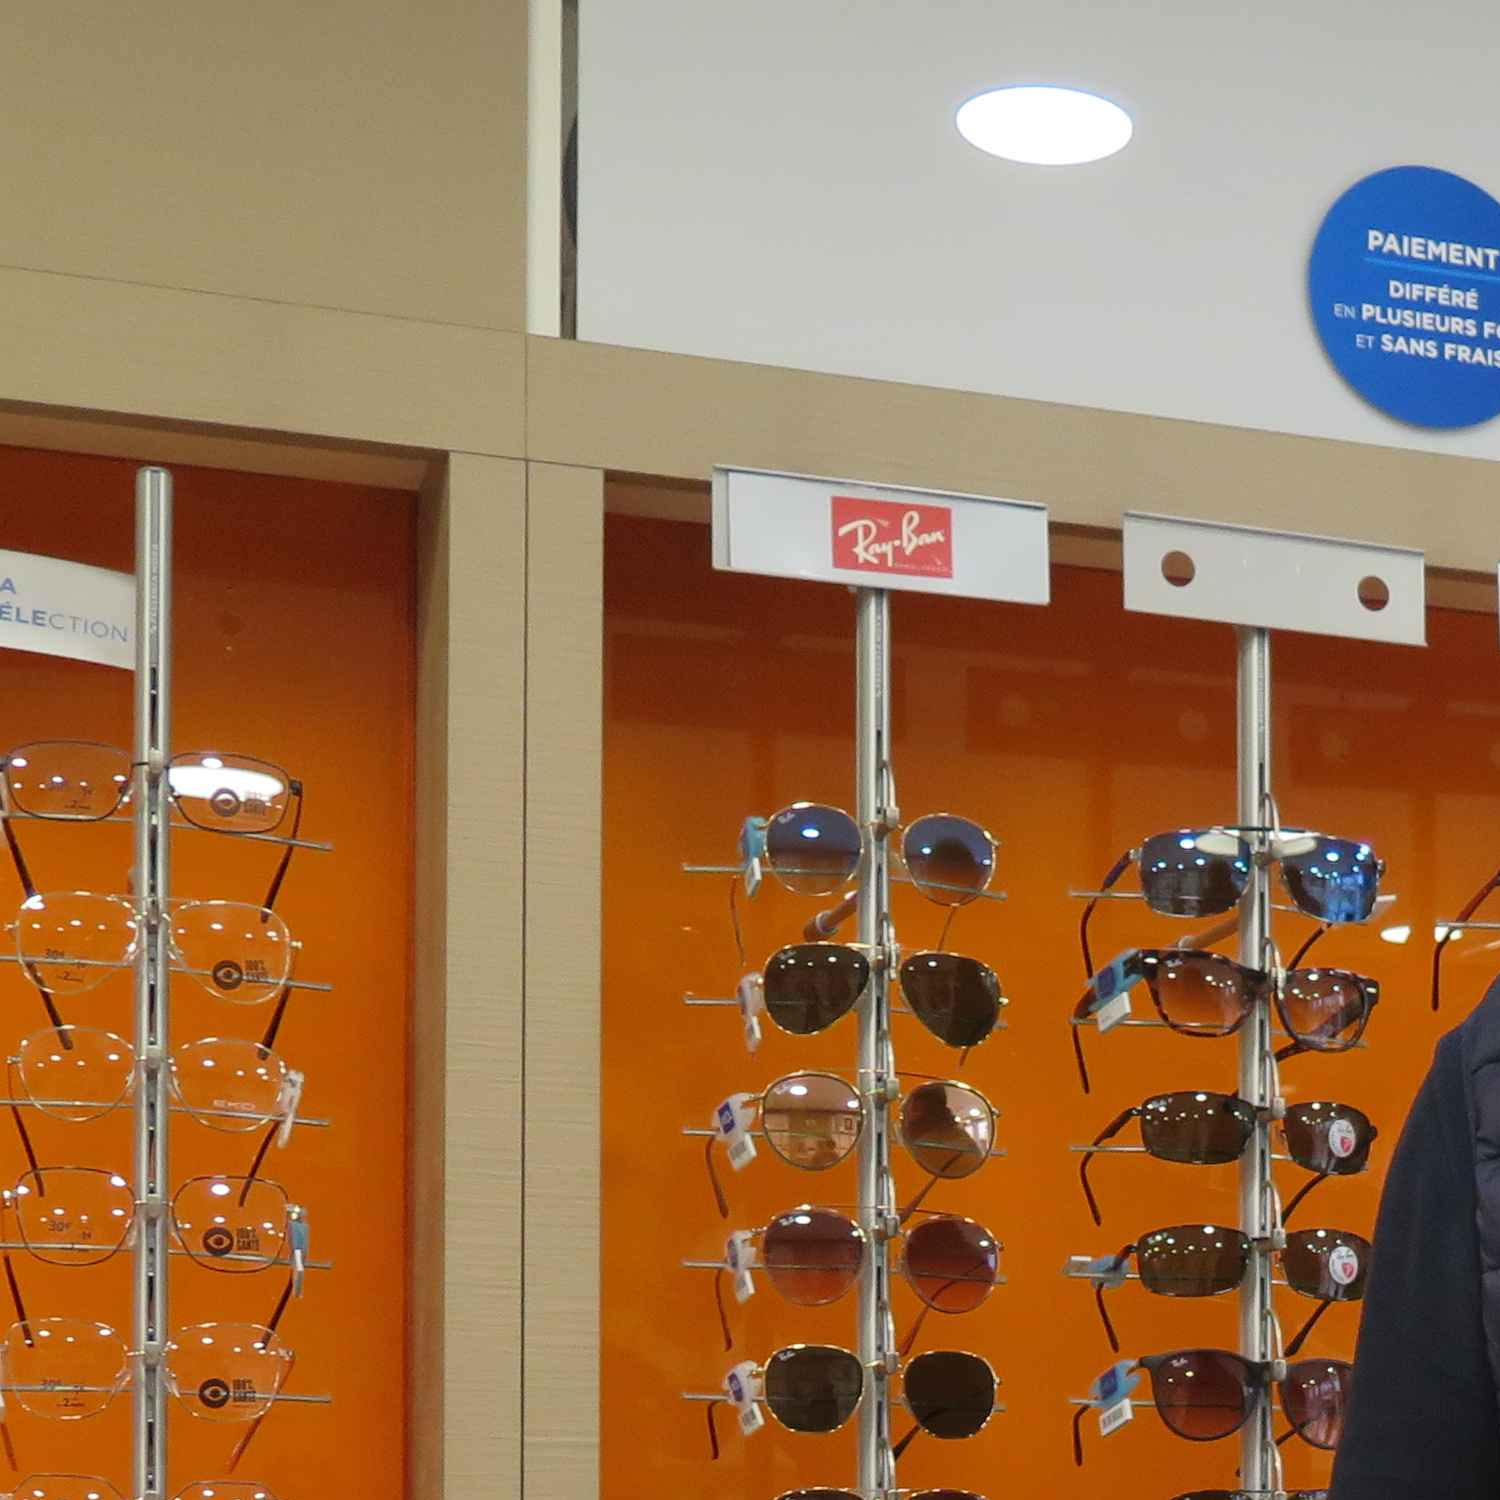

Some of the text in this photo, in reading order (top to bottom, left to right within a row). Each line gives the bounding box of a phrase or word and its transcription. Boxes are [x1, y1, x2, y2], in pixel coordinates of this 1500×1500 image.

[1367, 229, 1500, 270] PAIEMENT
[1388, 279, 1479, 310] DIFFÉRÉ
[1333, 303, 1356, 320] EN
[1361, 303, 1477, 337] PLUSIEURS
[1355, 335, 1375, 350] ET
[1380, 334, 1439, 359] SANS
[838, 510, 945, 567] Ray-Ban
